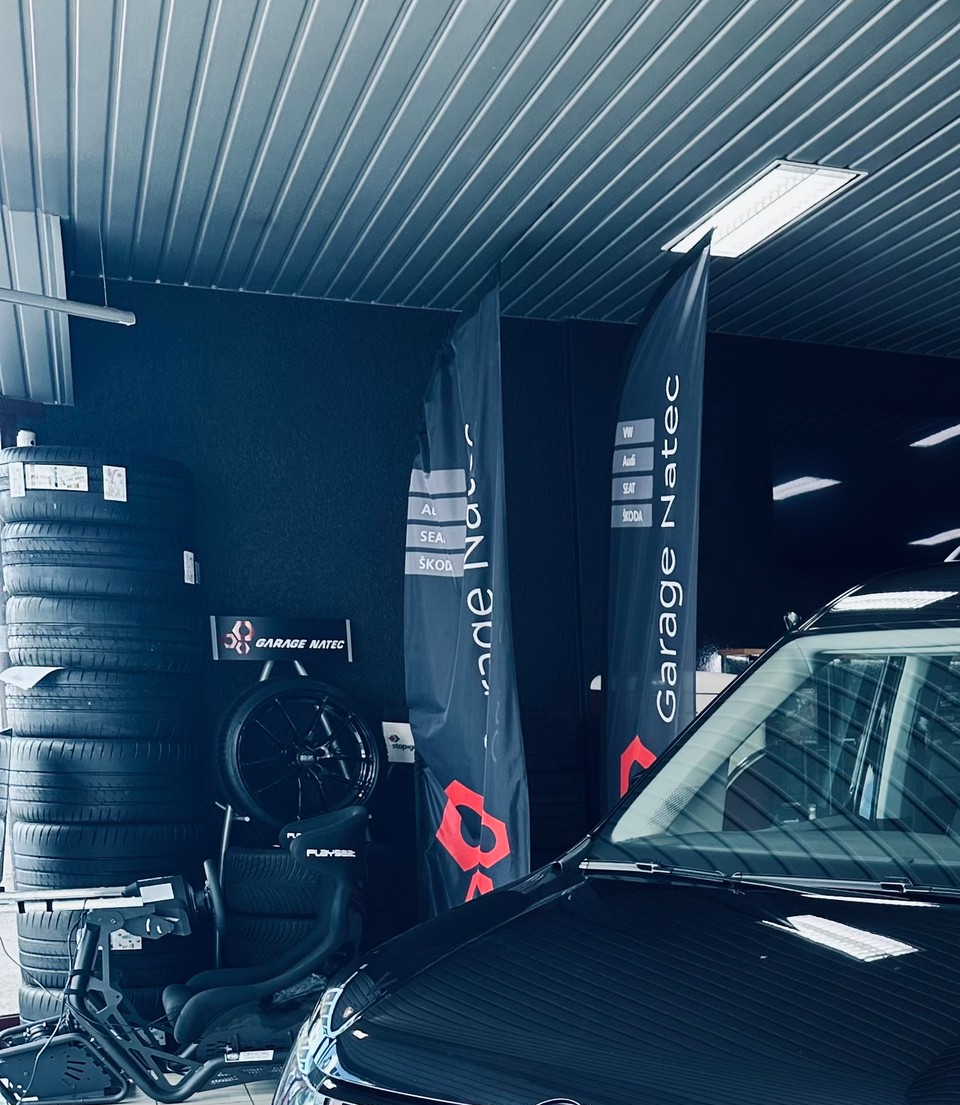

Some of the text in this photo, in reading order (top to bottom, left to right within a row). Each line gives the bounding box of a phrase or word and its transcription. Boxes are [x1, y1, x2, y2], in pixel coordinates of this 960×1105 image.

[622, 426, 634, 439] VW
[622, 454, 636, 467] Audi
[622, 482, 636, 495] SEAT
[622, 508, 643, 523] ŠKODA
[420, 530, 446, 543] SEA
[656, 374, 682, 724] Garage Natec
[419, 555, 453, 572] ŠKOD
[255, 638, 345, 649] GARAGE NATEC
